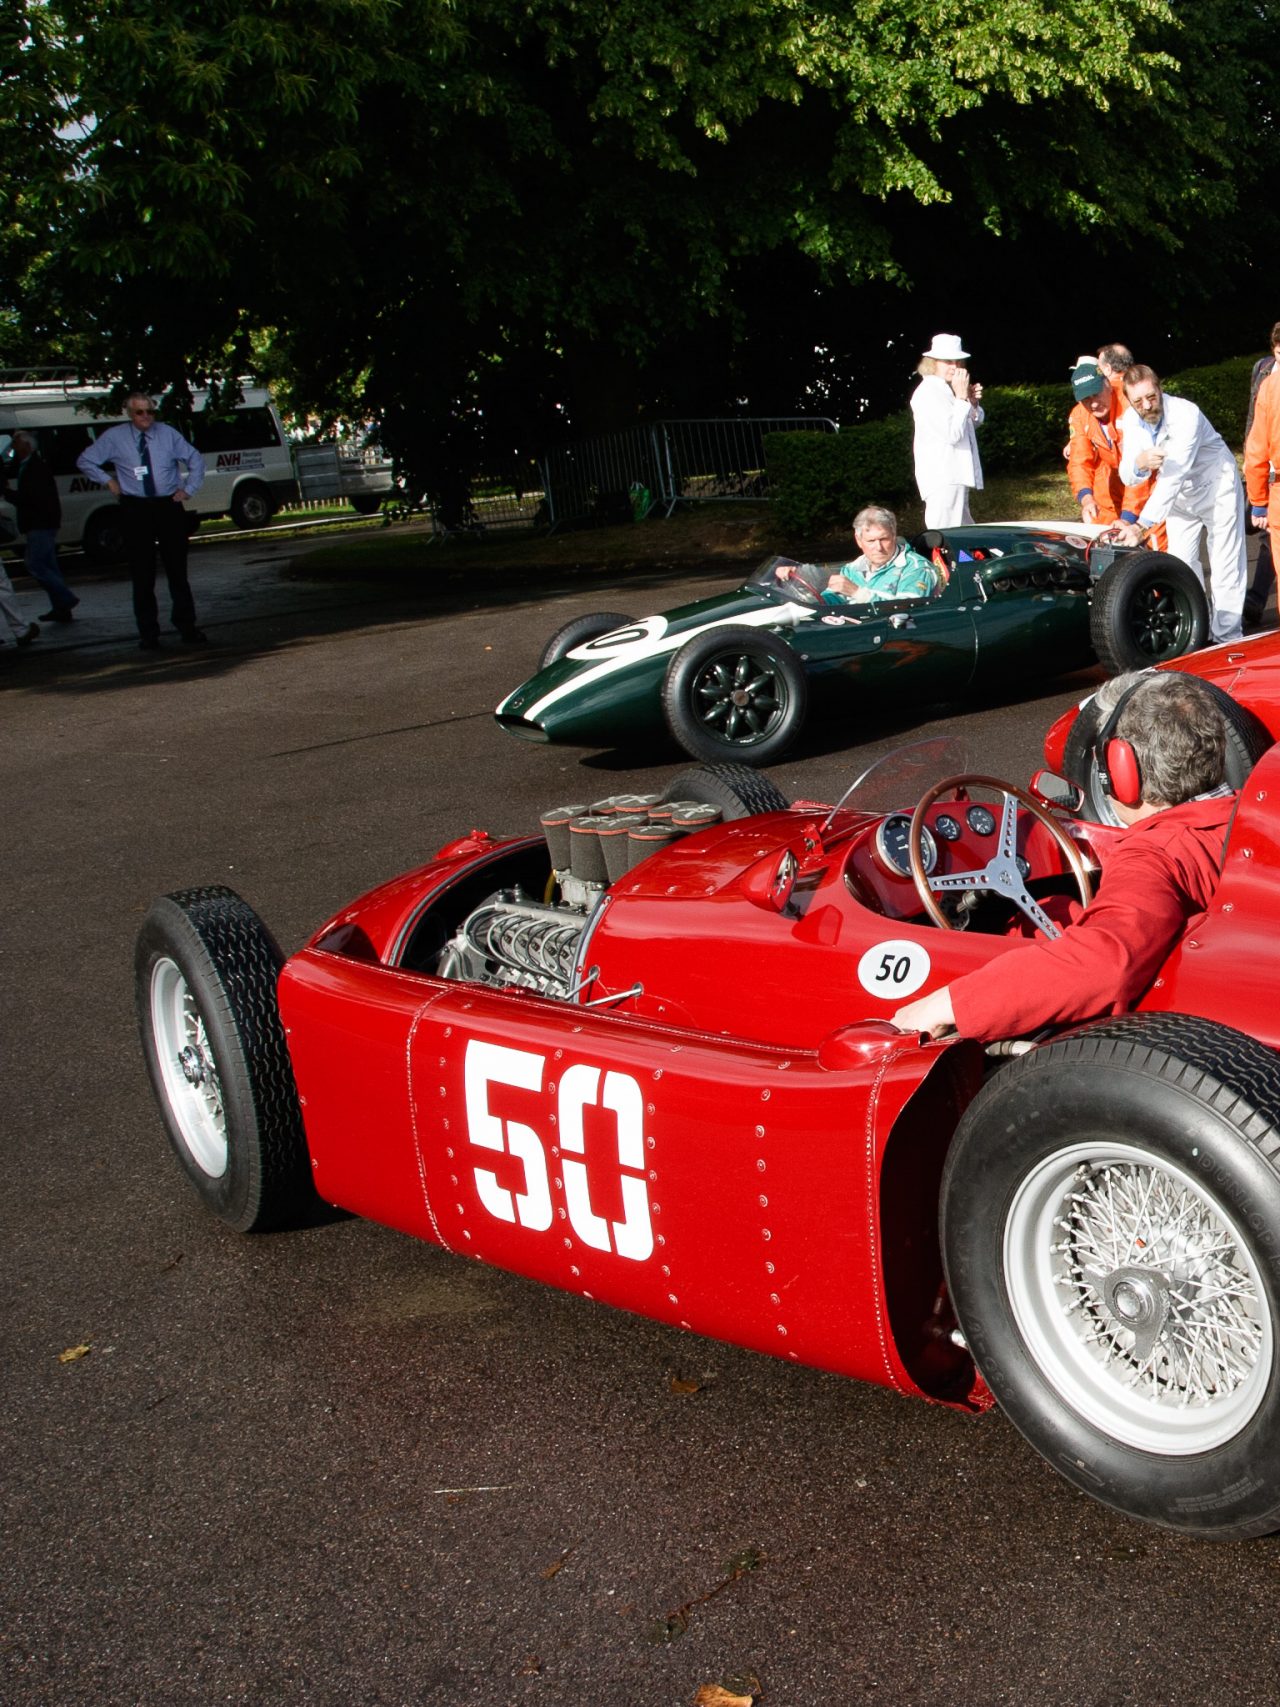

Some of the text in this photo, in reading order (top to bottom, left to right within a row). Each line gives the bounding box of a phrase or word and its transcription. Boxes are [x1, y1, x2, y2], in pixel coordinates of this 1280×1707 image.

[217, 453, 241, 467] AVH
[875, 954, 911, 984] 50
[464, 1039, 654, 1262] 50
[1200, 1150, 1276, 1245] DUNLOP
